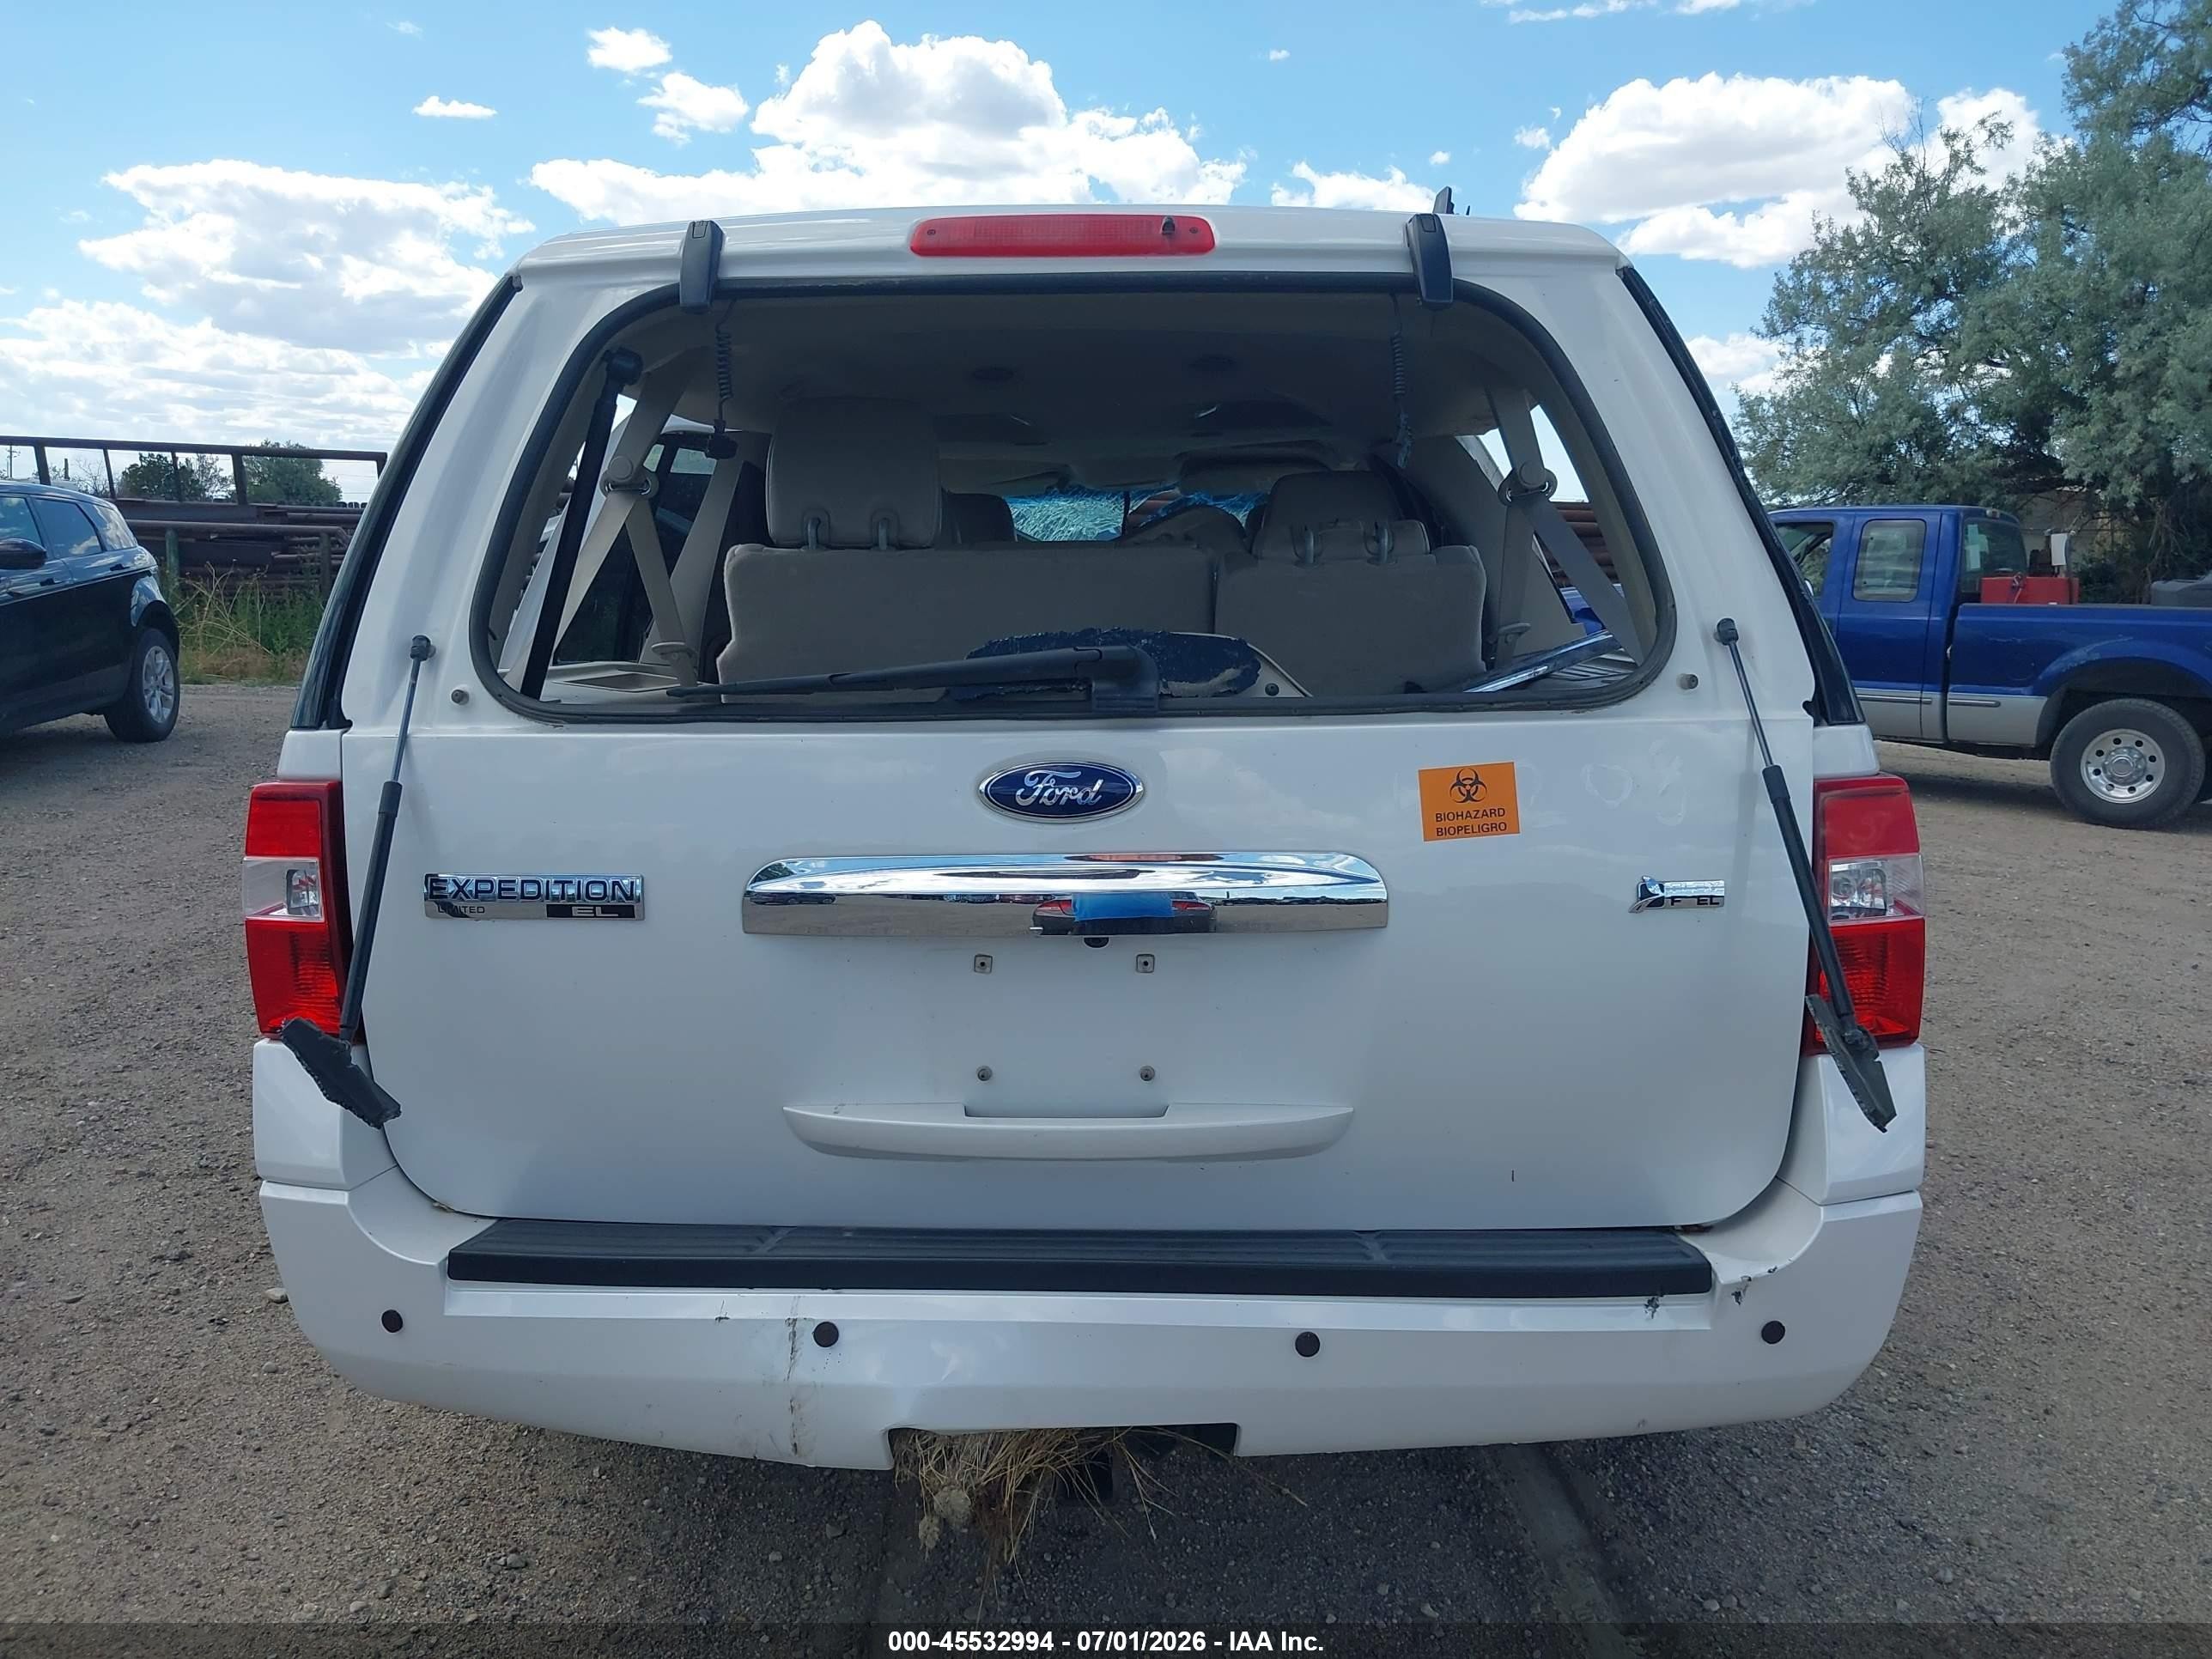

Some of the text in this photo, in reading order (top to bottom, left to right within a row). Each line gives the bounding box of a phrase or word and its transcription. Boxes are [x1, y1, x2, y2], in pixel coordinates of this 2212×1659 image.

[1016, 770, 1104, 806] Ford
[1436, 808, 1506, 823] BIOHAZARD
[1437, 822, 1508, 836] BIOPELIGRO
[429, 878, 636, 901] EXPEDITION
[438, 906, 485, 915] LITED
[571, 906, 619, 917] EL
